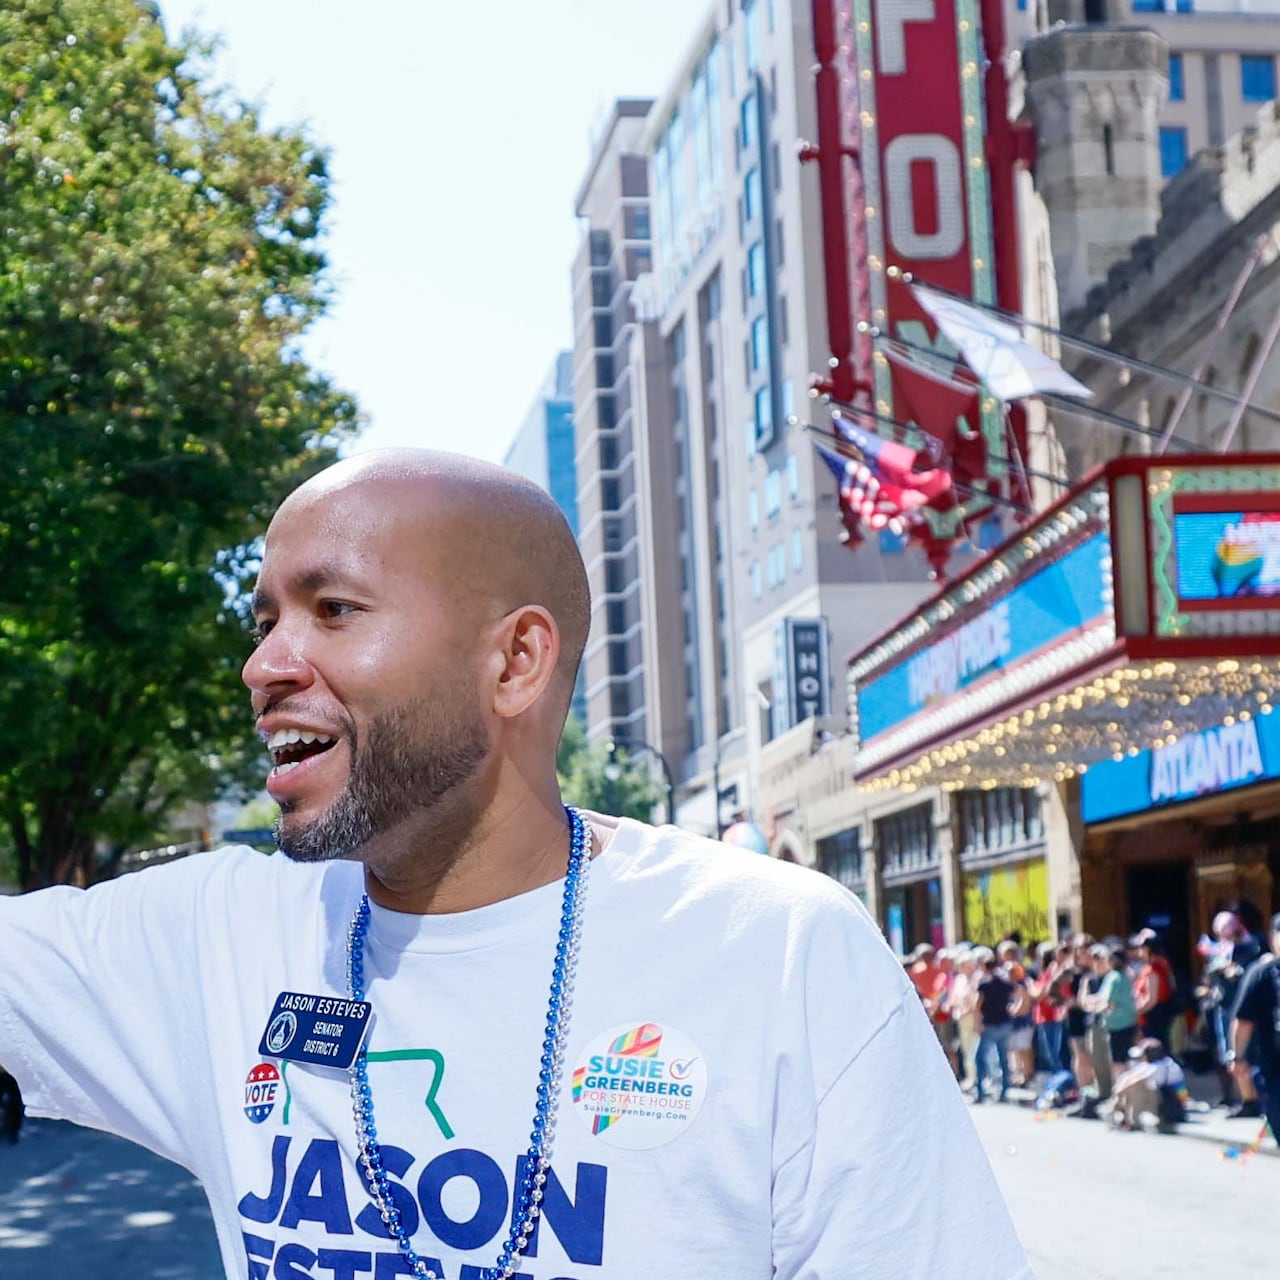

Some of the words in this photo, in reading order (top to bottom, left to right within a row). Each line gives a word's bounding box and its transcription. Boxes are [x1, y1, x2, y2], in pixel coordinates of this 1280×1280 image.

[1151, 719, 1264, 802] ATLANTA
[280, 994, 316, 1012] JASON
[316, 999, 367, 1019] ESTEVES
[312, 1021, 344, 1038] SENATOR
[303, 1039, 333, 1057] DISTRICT
[332, 1043, 340, 1057] 6
[588, 1055, 665, 1079] SUSIE
[245, 1083, 279, 1104] VOTE
[584, 1076, 693, 1097] GREENBERG
[583, 1090, 607, 1101] FOR
[610, 1093, 647, 1106] STATE
[649, 1096, 691, 1110] HOUSE
[237, 1134, 609, 1266] JASON
